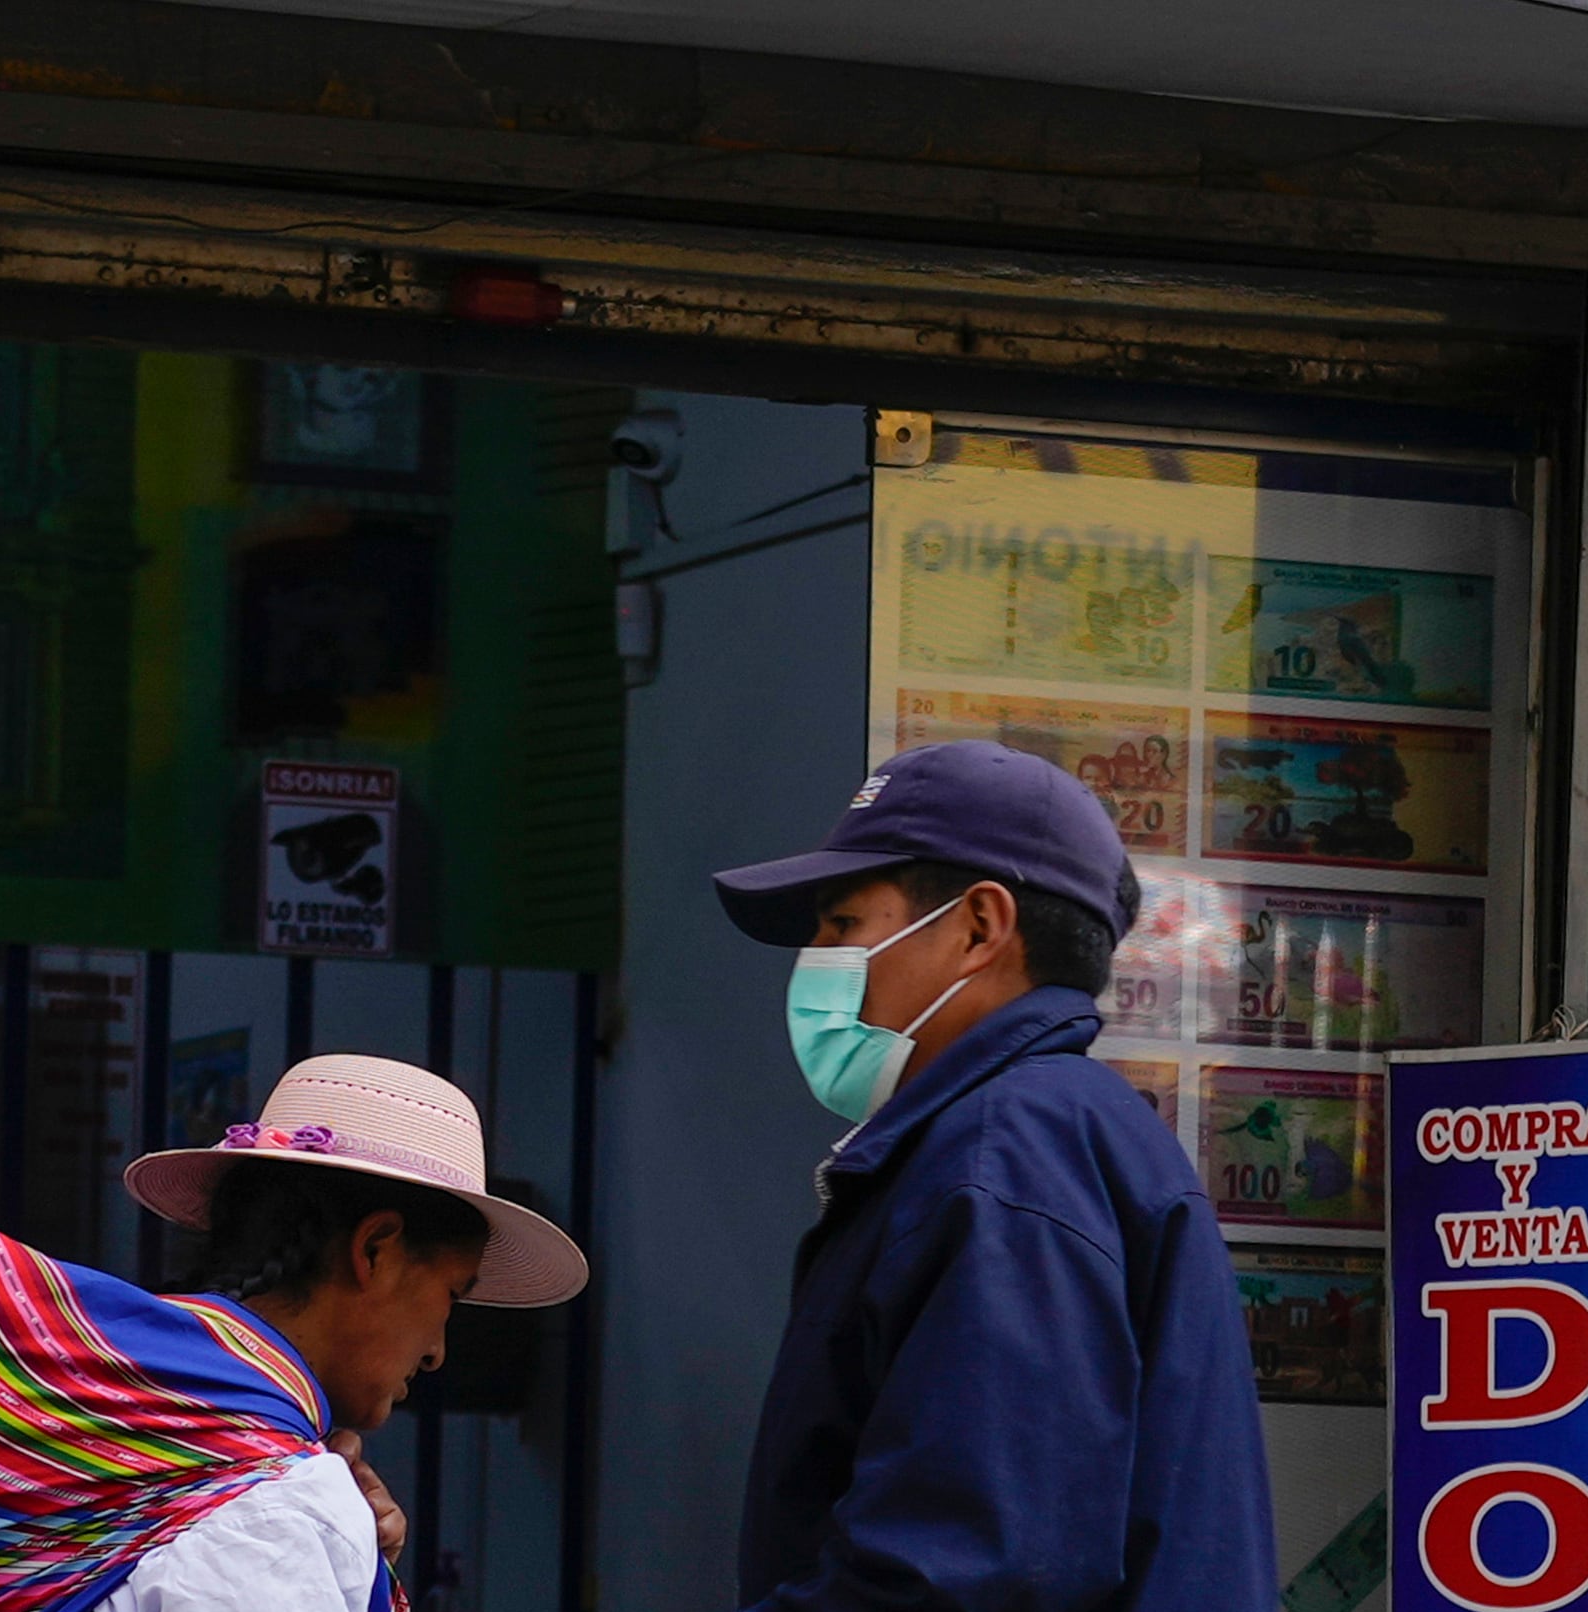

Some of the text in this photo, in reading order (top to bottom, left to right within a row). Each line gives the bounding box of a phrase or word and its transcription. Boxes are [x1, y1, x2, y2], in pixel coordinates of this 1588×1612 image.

[1275, 644, 1317, 677] 10
[1120, 799, 1165, 832] 20
[1243, 803, 1292, 839] 20
[268, 900, 387, 926] LO ESTAMOS
[1114, 977, 1159, 1011] 50
[1238, 982, 1286, 1018] 50
[1222, 1164, 1281, 1201] 100
[1502, 1163, 1532, 1206] Y
